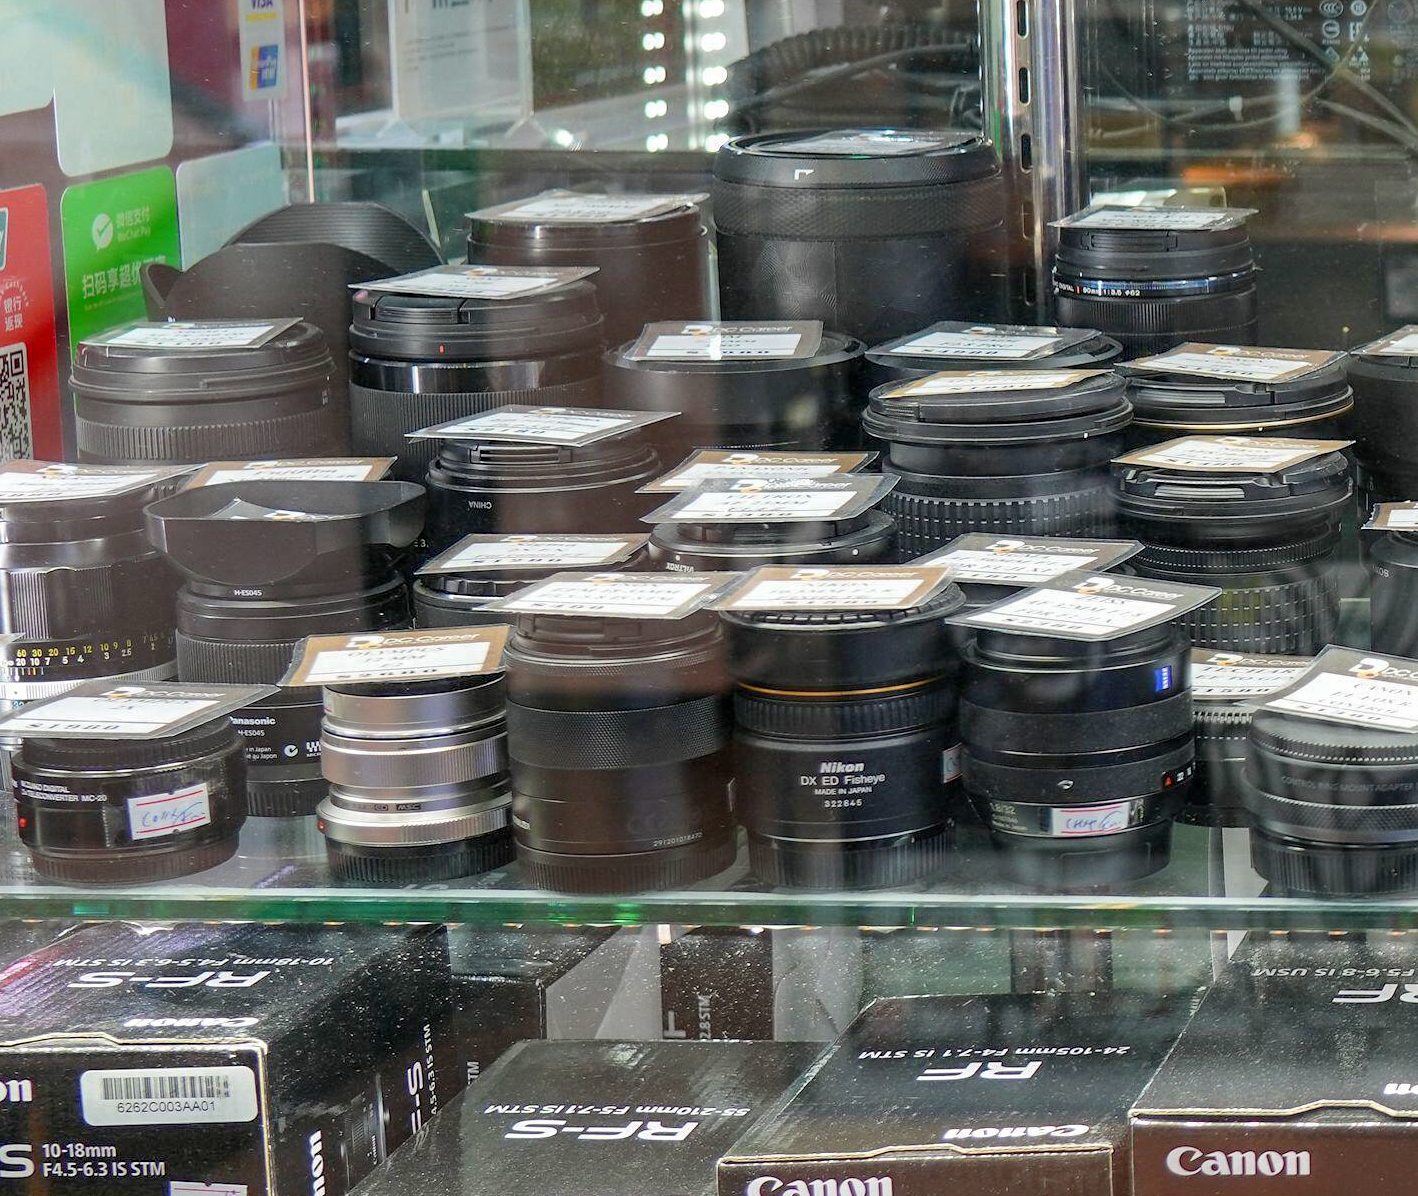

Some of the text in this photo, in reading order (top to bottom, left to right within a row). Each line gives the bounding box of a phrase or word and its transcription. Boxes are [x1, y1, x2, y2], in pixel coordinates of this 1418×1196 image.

[468, 500, 493, 510] CHINA
[819, 761, 865, 774] Nikon
[800, 773, 886, 786] DX ED Fisheye
[67, 970, 272, 989] RF-S
[123, 1017, 260, 1029] Canon
[916, 1061, 1043, 1082] RF
[116, 1100, 217, 1114] 6262C003AA01
[635, 1105, 751, 1117] 55-210mm
[504, 1119, 699, 1141] RF-S
[945, 1123, 1090, 1139] Canon
[42, 1142, 117, 1159] 10-18mm
[42, 1161, 111, 1178] F4.5-6.3
[129, 1160, 166, 1177] STM
[1166, 1145, 1311, 1178] Canon
[746, 1175, 893, 1196] Canon
